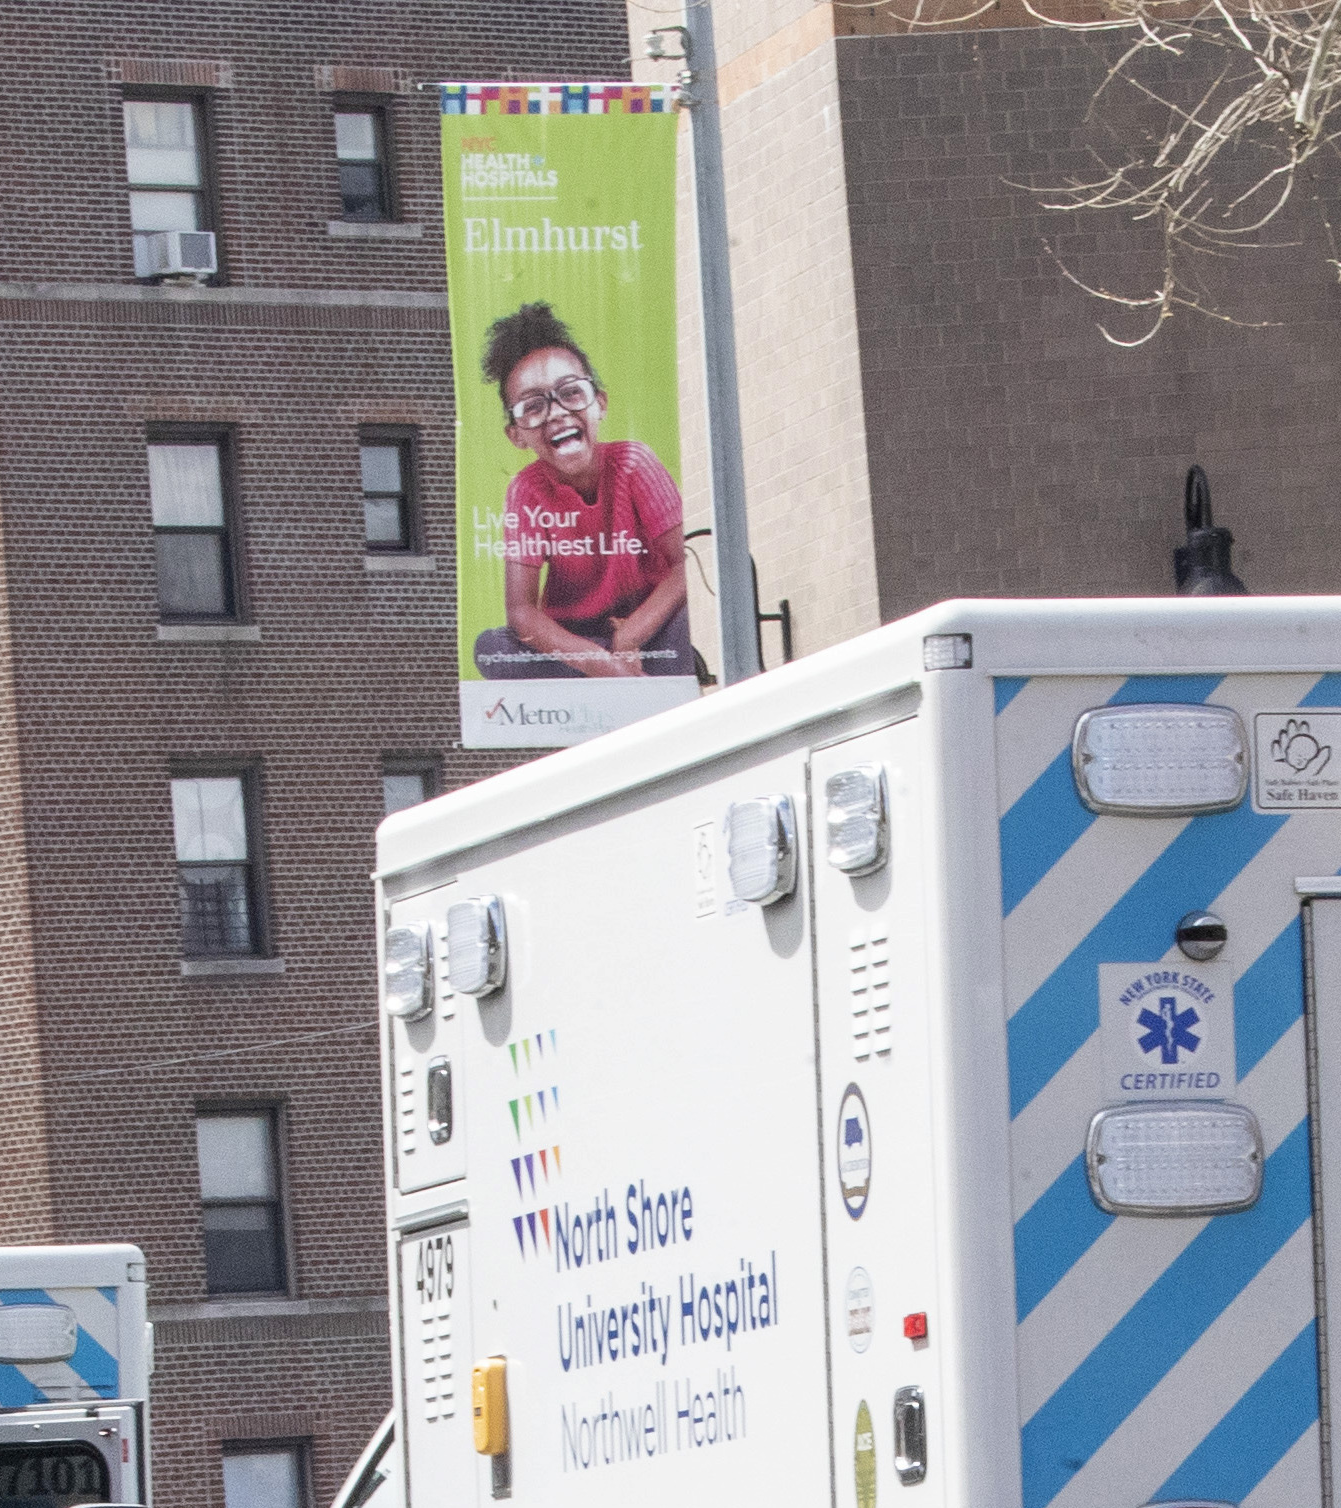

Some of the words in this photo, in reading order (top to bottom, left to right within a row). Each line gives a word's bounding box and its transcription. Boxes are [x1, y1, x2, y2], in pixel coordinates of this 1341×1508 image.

[461, 153, 531, 170] HEALTH
[461, 170, 558, 187] HOSPITALS
[463, 217, 643, 253] Elmhurst
[472, 505, 520, 531] Live
[523, 505, 580, 528] Your
[474, 532, 595, 559] Healthiest
[599, 530, 649, 556] Life.
[1266, 788, 1295, 801] Safe
[1298, 788, 1339, 801] Haven
[1119, 979, 1145, 1006] NEW
[1144, 971, 1180, 987] YORK
[1182, 975, 1216, 1005] STATE
[1120, 1072, 1221, 1091] CERTIFIED
[555, 1188, 618, 1273] North
[626, 1179, 693, 1255] Shore
[416, 1234, 455, 1305] 4979
[558, 1281, 671, 1373] University
[679, 1250, 778, 1351] Hospital
[561, 1380, 668, 1473] Northwell
[675, 1365, 746, 1451] Health
